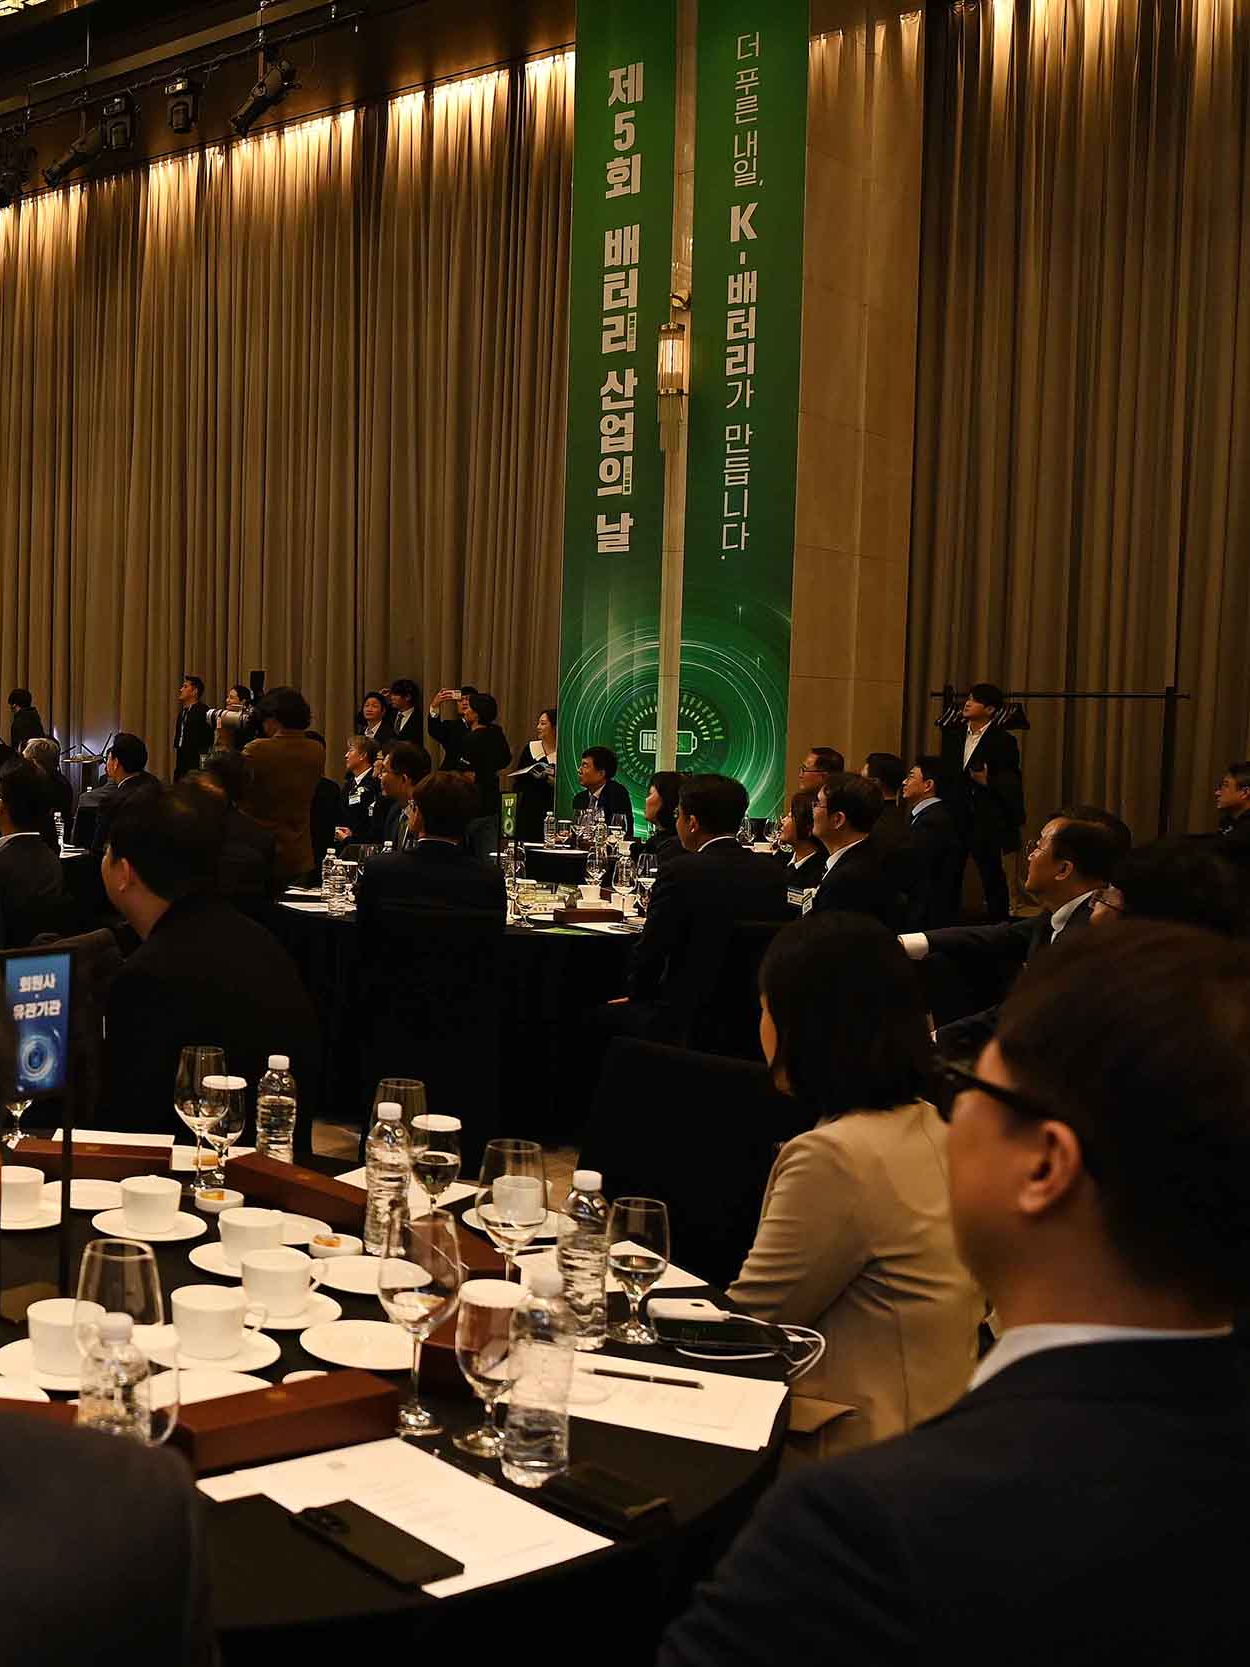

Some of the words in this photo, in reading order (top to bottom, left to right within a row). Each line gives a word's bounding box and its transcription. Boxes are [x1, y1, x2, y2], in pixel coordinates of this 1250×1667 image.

[736, 31, 760, 61] 더
[734, 67, 759, 125] 푸른
[605, 62, 644, 200] 제5회
[733, 130, 765, 188] 내일,
[601, 223, 640, 354] 배터리
[725, 202, 759, 409] K-배터리가
[596, 368, 639, 497] 산업의
[721, 423, 754, 560] 만듭니다.
[596, 512, 634, 553] 날
[12, 999, 63, 1021] 유관기관
[18, 973, 57, 993] 회원사
